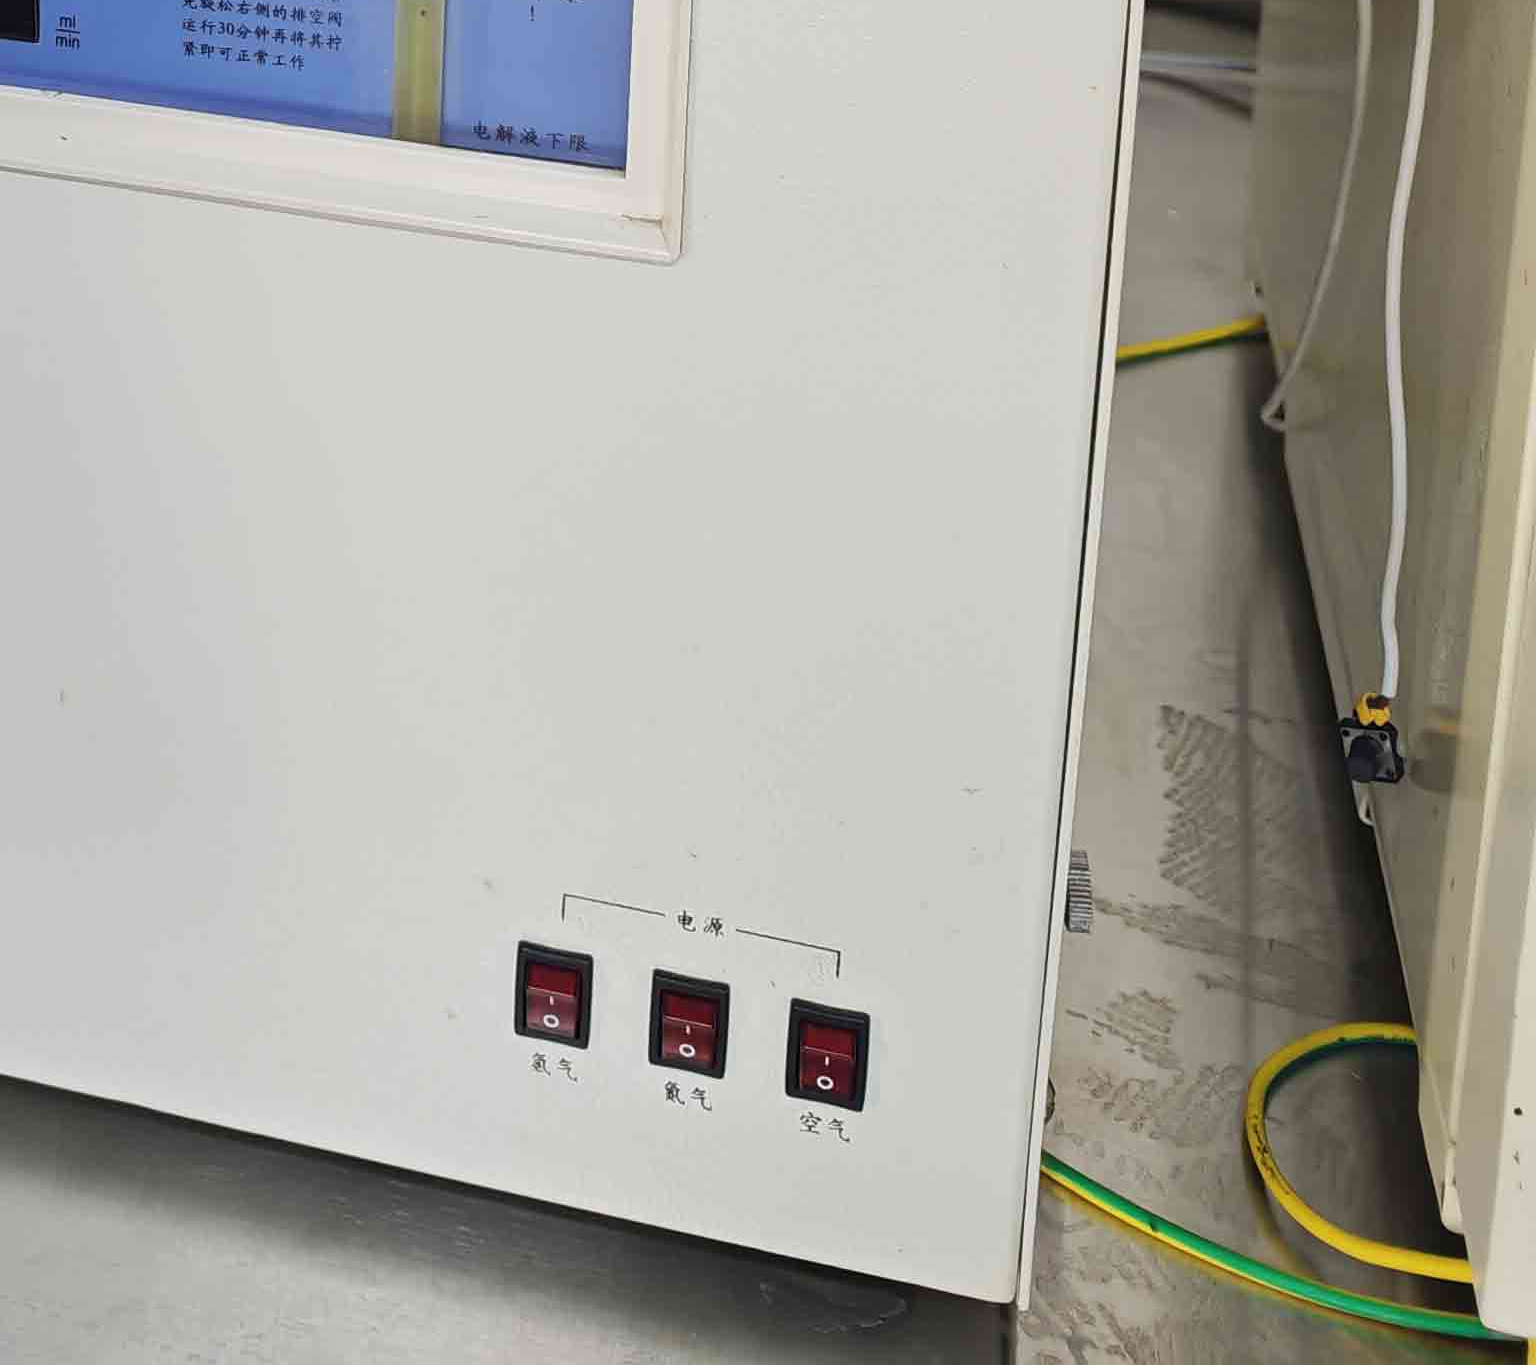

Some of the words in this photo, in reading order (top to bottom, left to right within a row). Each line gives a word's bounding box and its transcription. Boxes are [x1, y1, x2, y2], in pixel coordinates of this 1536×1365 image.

[55, 33, 80, 50] min
[182, 18, 342, 51] 运行30分钟再将其拧
[182, 40, 305, 71] 紧即可正常工作
[471, 121, 591, 152] 电解液下限
[677, 910, 724, 937] 电源
[800, 1111, 851, 1142] 空气
